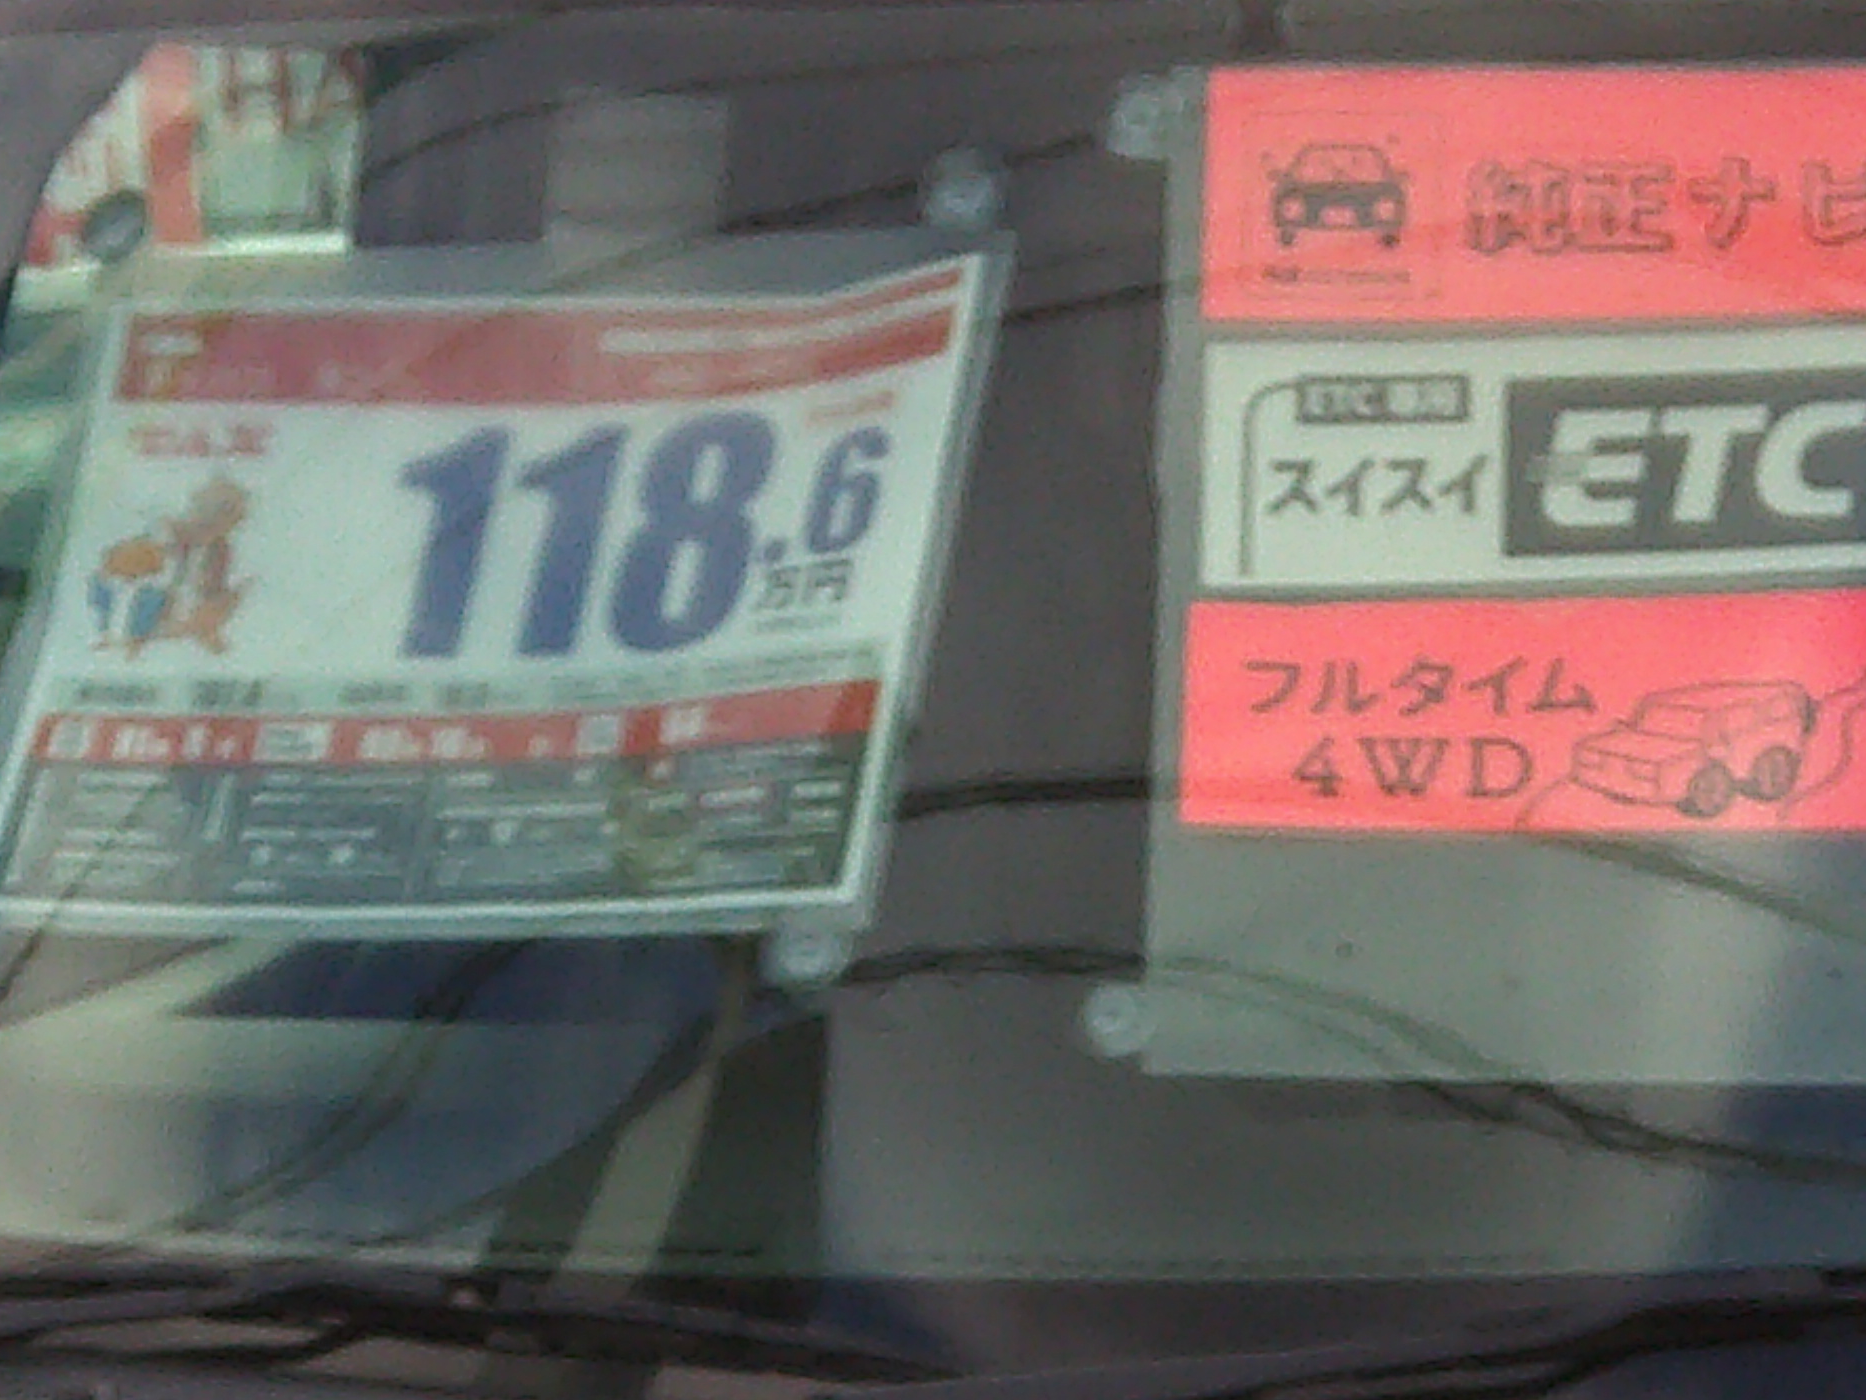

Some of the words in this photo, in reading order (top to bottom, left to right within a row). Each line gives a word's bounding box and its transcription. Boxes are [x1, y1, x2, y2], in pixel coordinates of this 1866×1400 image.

[1265, 454, 1489, 516] スイスイ
[1244, 655, 1597, 716] フルタイム
[1292, 735, 1533, 798] 4WD
